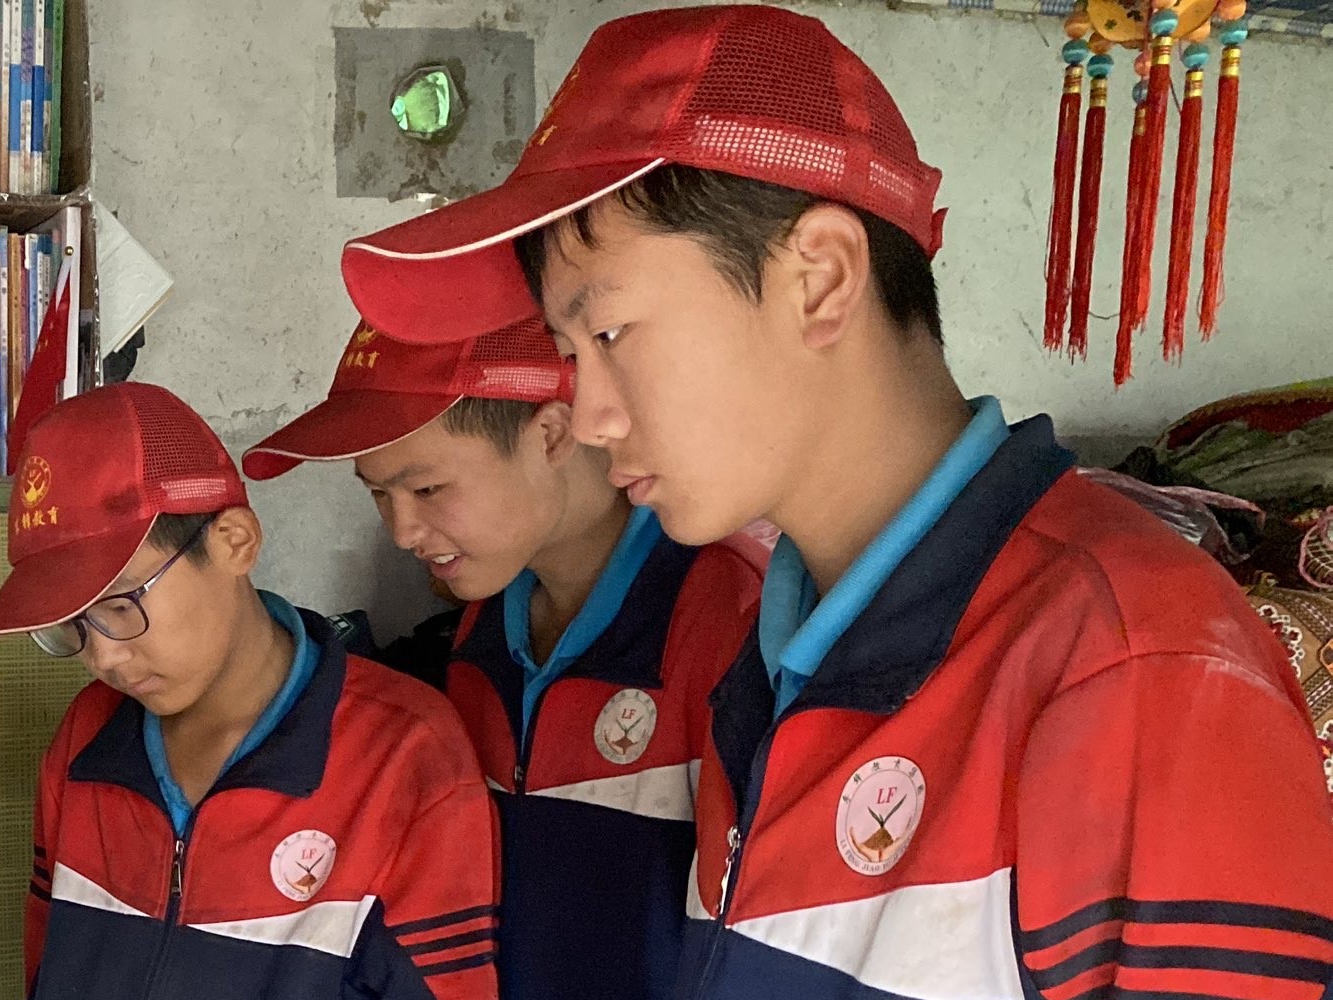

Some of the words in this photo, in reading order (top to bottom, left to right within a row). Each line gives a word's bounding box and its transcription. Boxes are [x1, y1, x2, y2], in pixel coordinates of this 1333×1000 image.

[621, 708, 637, 720] LF
[876, 786, 898, 805] LF
[301, 847, 317, 860] LF
